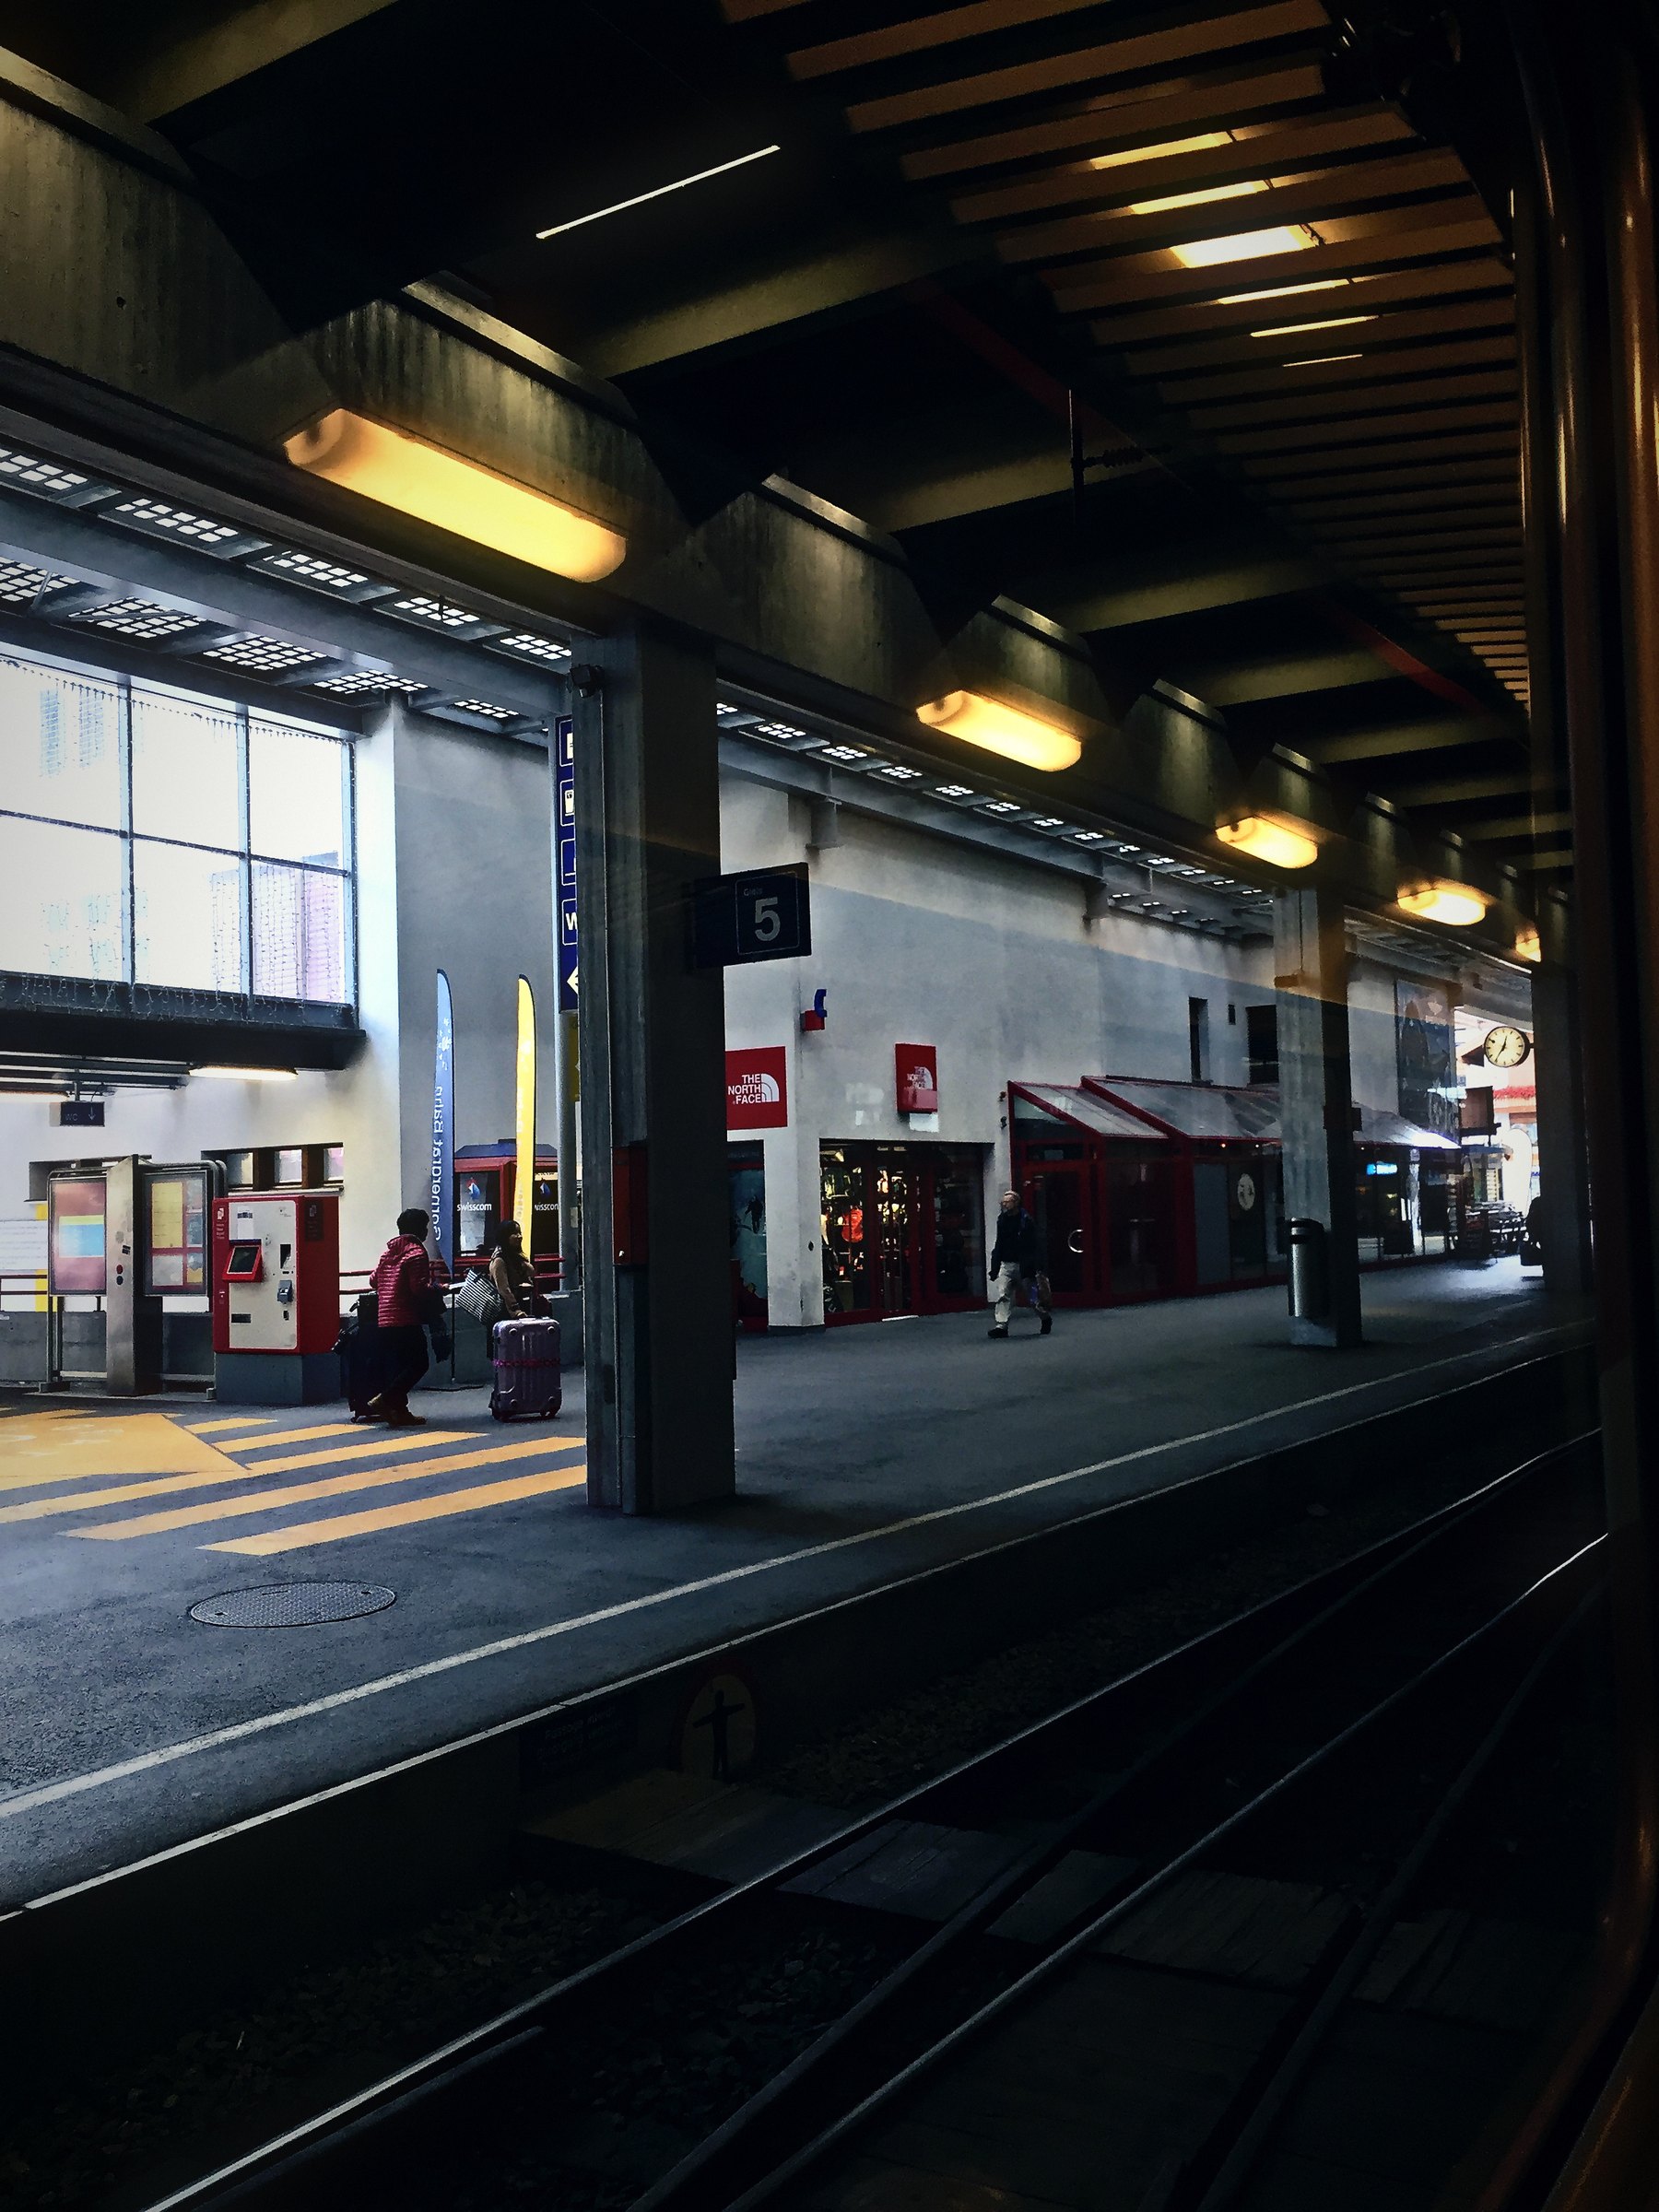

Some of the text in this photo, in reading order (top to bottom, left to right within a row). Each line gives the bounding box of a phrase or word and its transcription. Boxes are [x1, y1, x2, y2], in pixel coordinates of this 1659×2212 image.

[754, 897, 782, 942] 5
[741, 1074, 761, 1084] THE
[727, 1084, 761, 1096] NORTH
[735, 1094, 761, 1105] FACE
[65, 1112, 78, 1122] WC
[456, 1201, 492, 1212] swisscom
